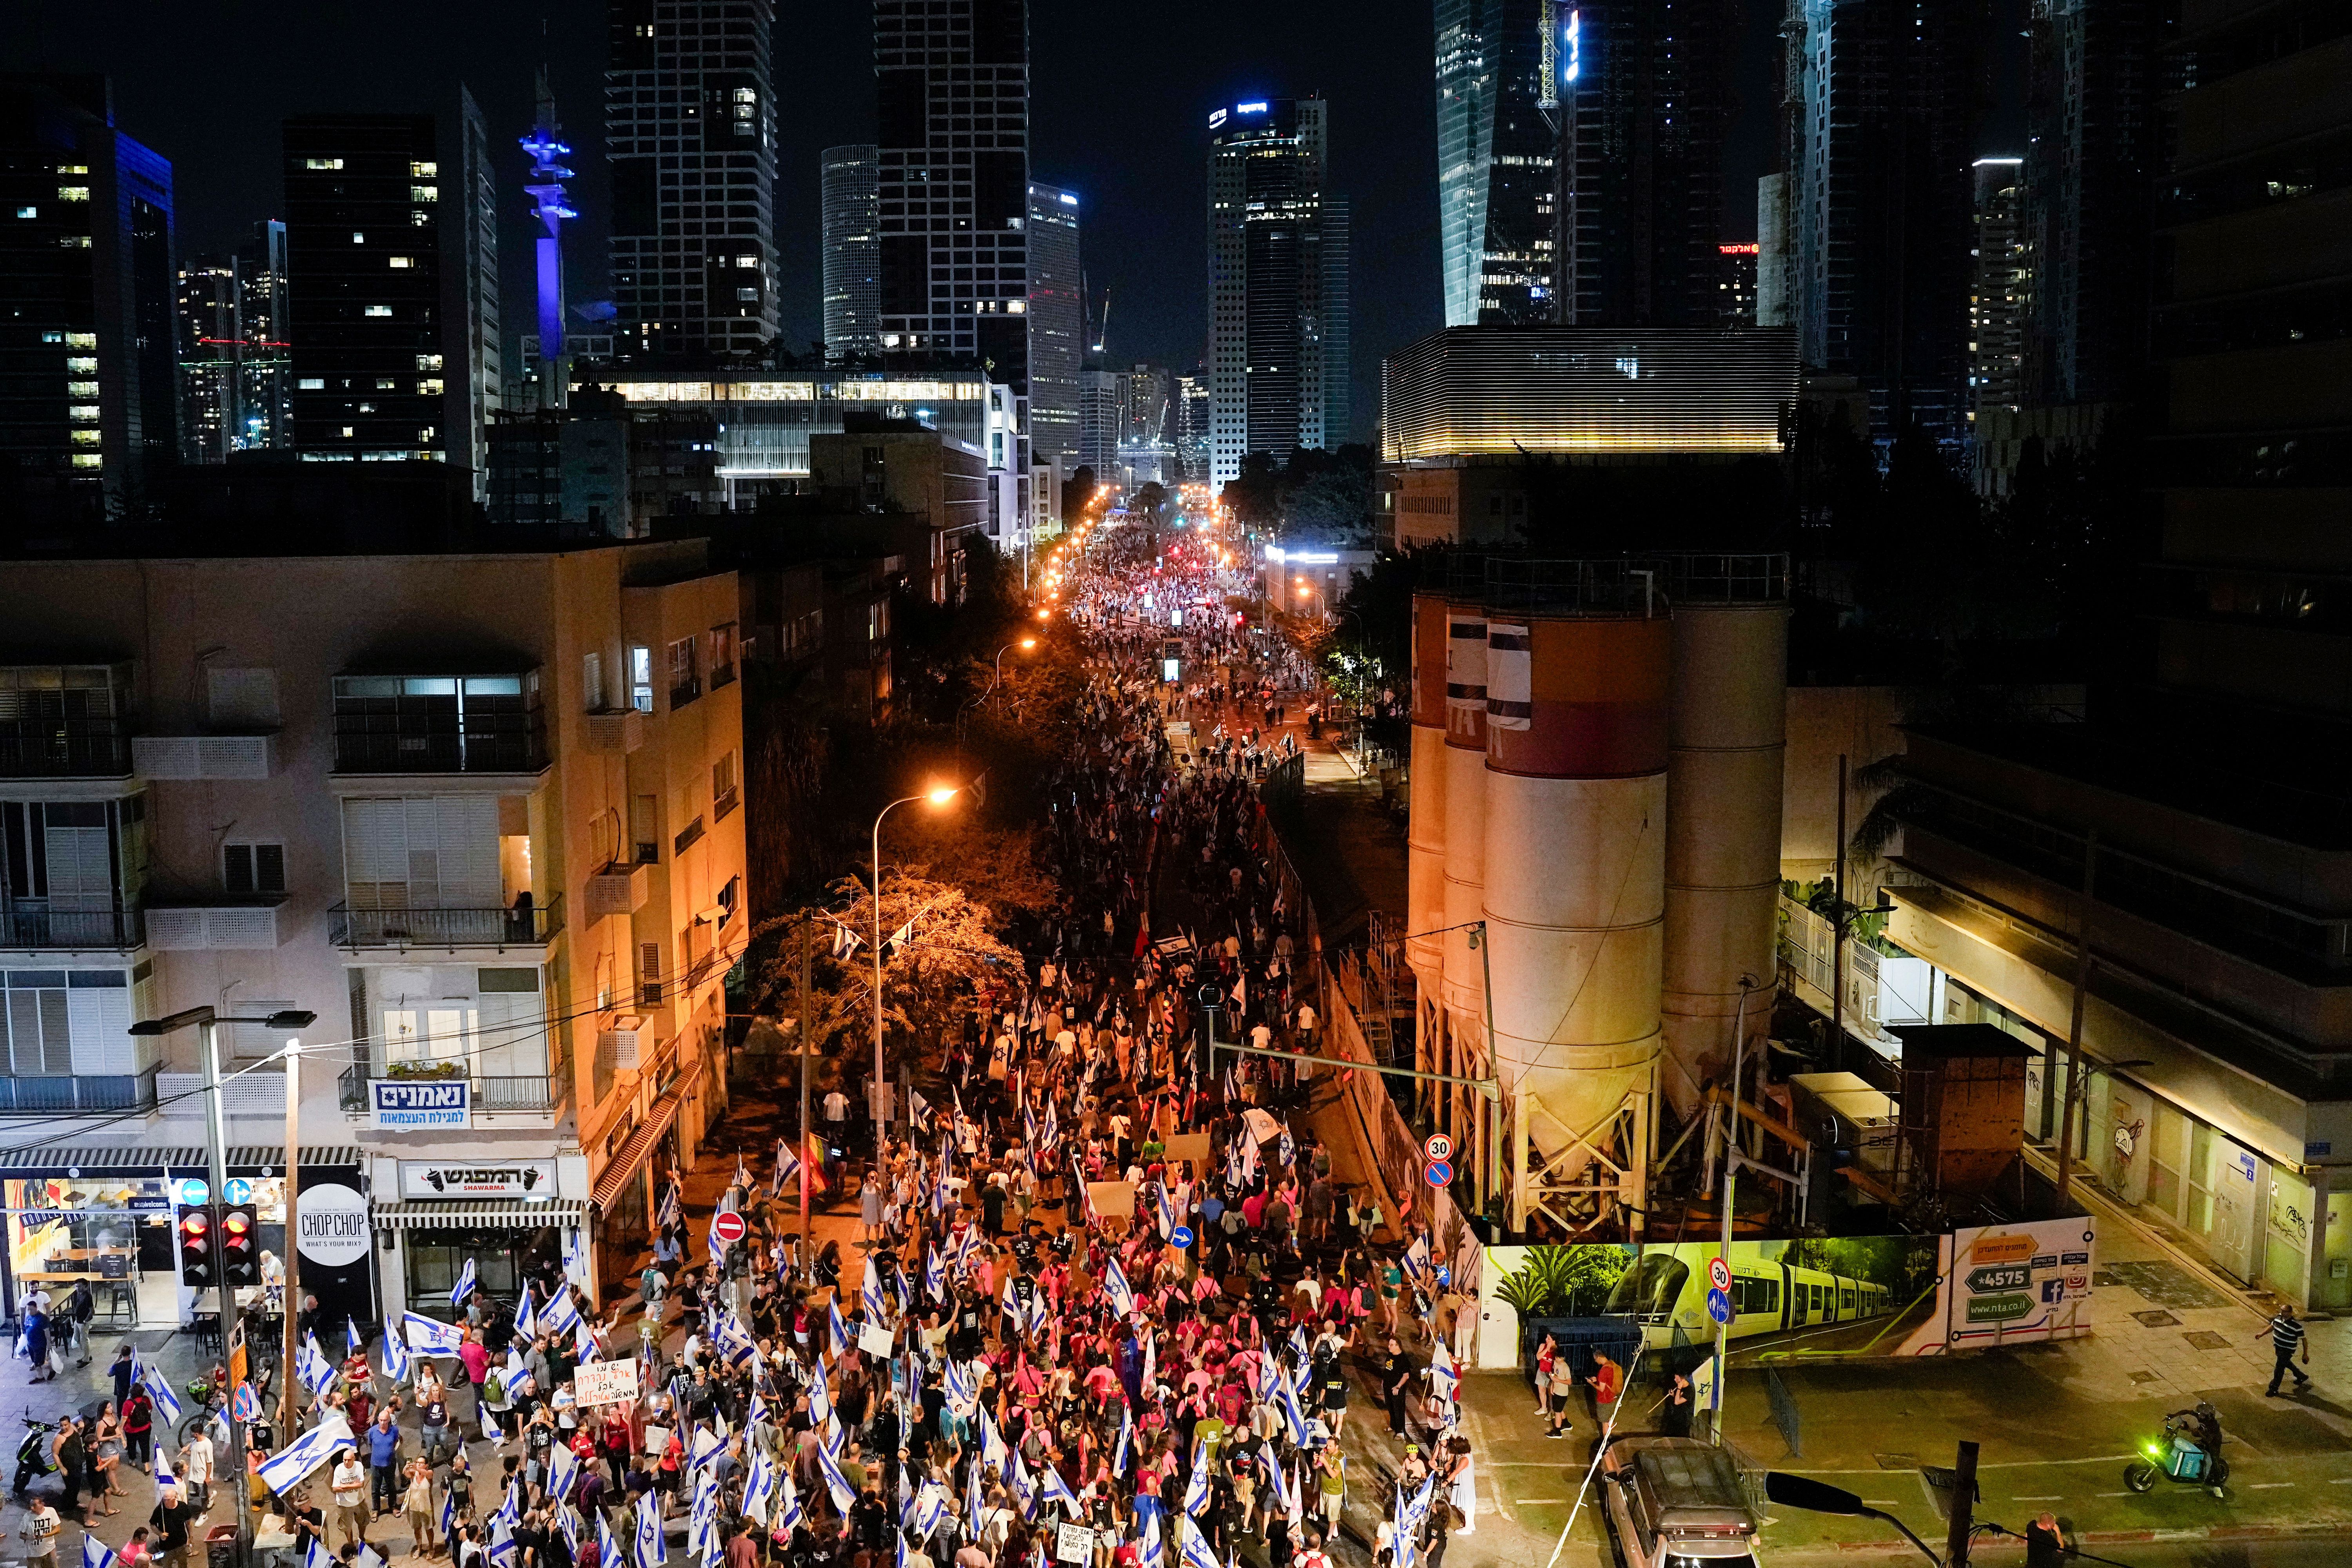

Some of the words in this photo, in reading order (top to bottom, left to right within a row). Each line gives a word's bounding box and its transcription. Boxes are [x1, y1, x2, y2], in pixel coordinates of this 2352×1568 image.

[381, 1087, 461, 1106] נאמנים
[380, 1112, 426, 1123] העצמאות
[429, 1110, 464, 1123] למגילת
[1432, 1142, 1447, 1154] 30
[443, 1169, 521, 1184] המפגש
[302, 1215, 332, 1236] CHOP
[334, 1214, 364, 1235] CHOP
[1978, 1245, 2004, 1254] להתעדכן
[1715, 1267, 1726, 1284] 30
[1734, 1265, 1750, 1274] דנקל
[1971, 1300, 2025, 1314] www.nta.co.il
[597, 1363, 608, 1372] לנו
[611, 1368, 631, 1379] ארץ
[577, 1373, 606, 1386] נהדרת
[598, 1381, 614, 1391] אבל
[578, 1390, 610, 1405] מטורללת
[612, 1389, 635, 1399] ממשלה
[34, 1518, 50, 1528] דמו
